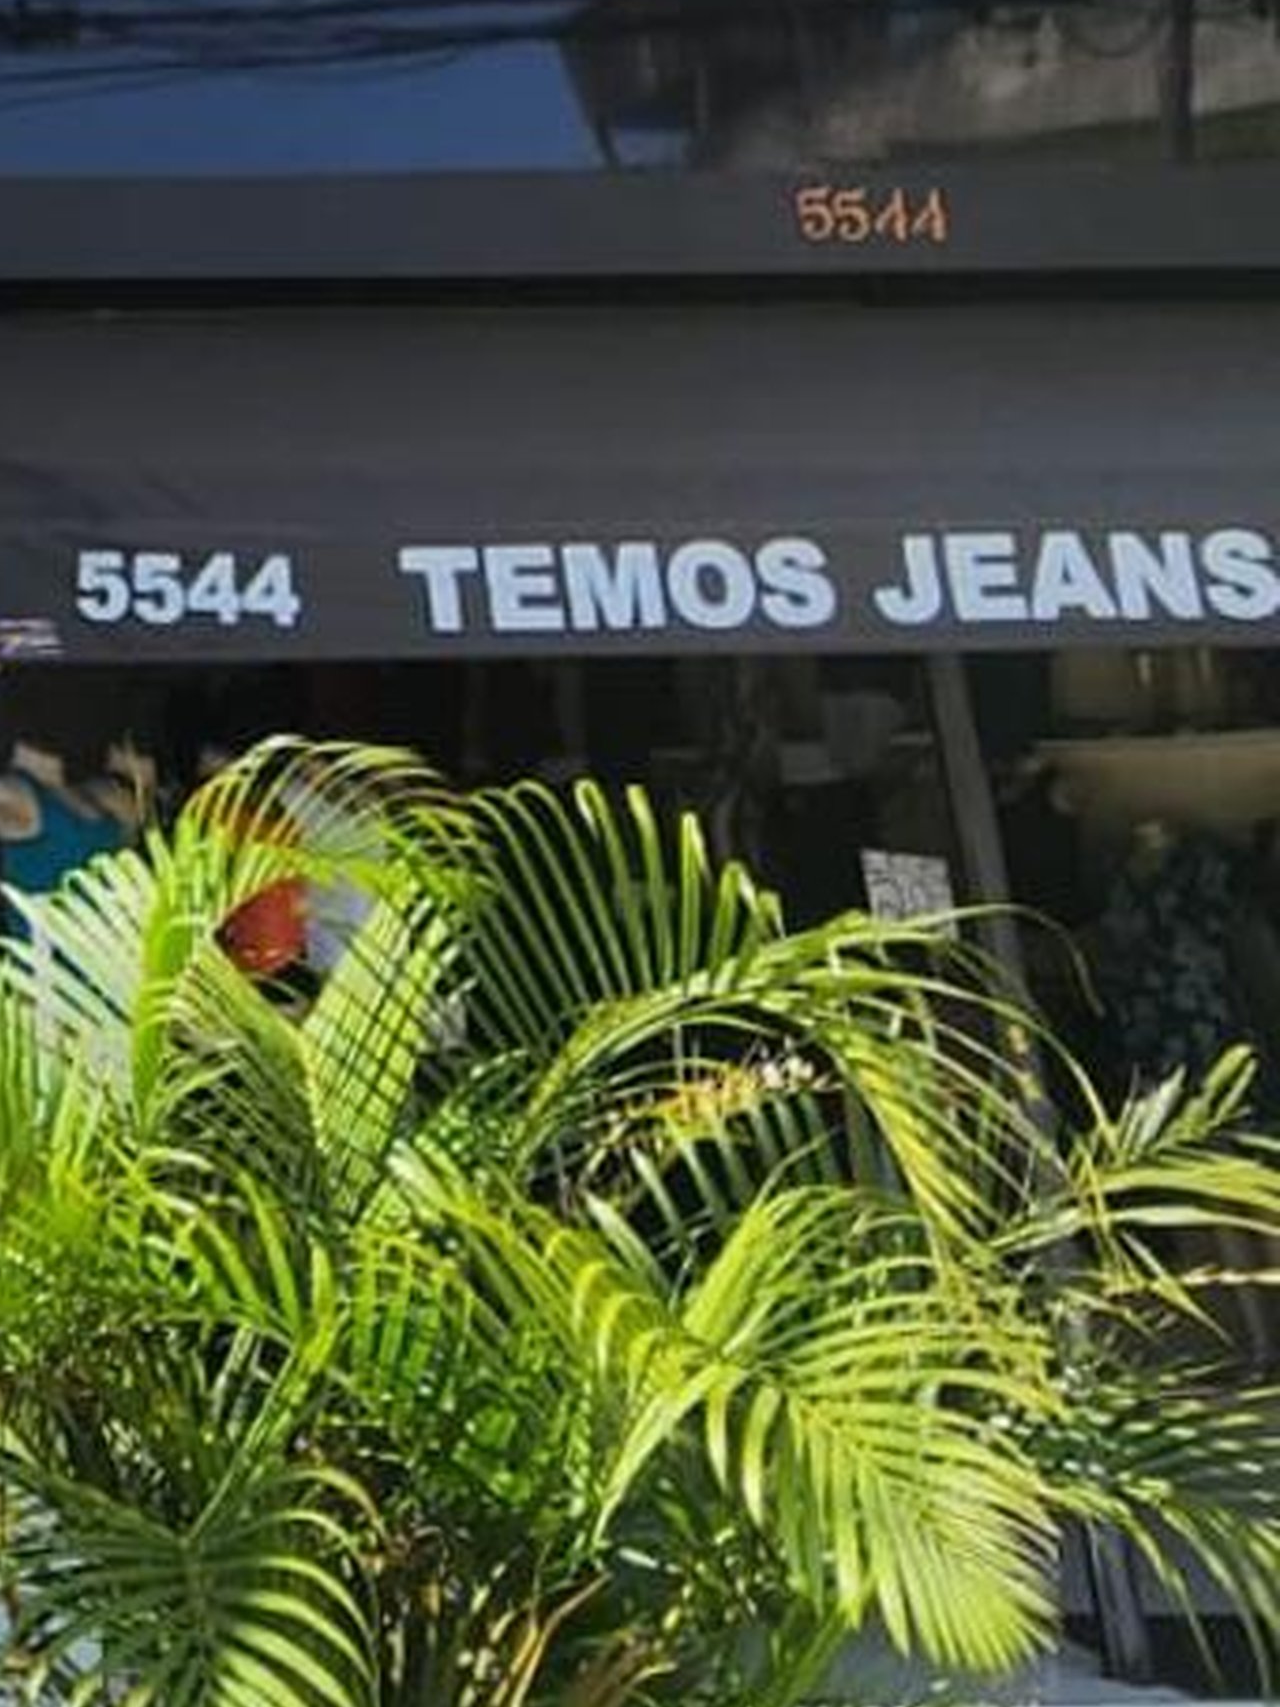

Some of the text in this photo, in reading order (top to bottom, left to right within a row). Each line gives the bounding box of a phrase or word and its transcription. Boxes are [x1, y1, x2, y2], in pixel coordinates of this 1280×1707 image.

[795, 185, 948, 242] 5544
[74, 528, 1280, 632] 5544 TEMOS JEANS
